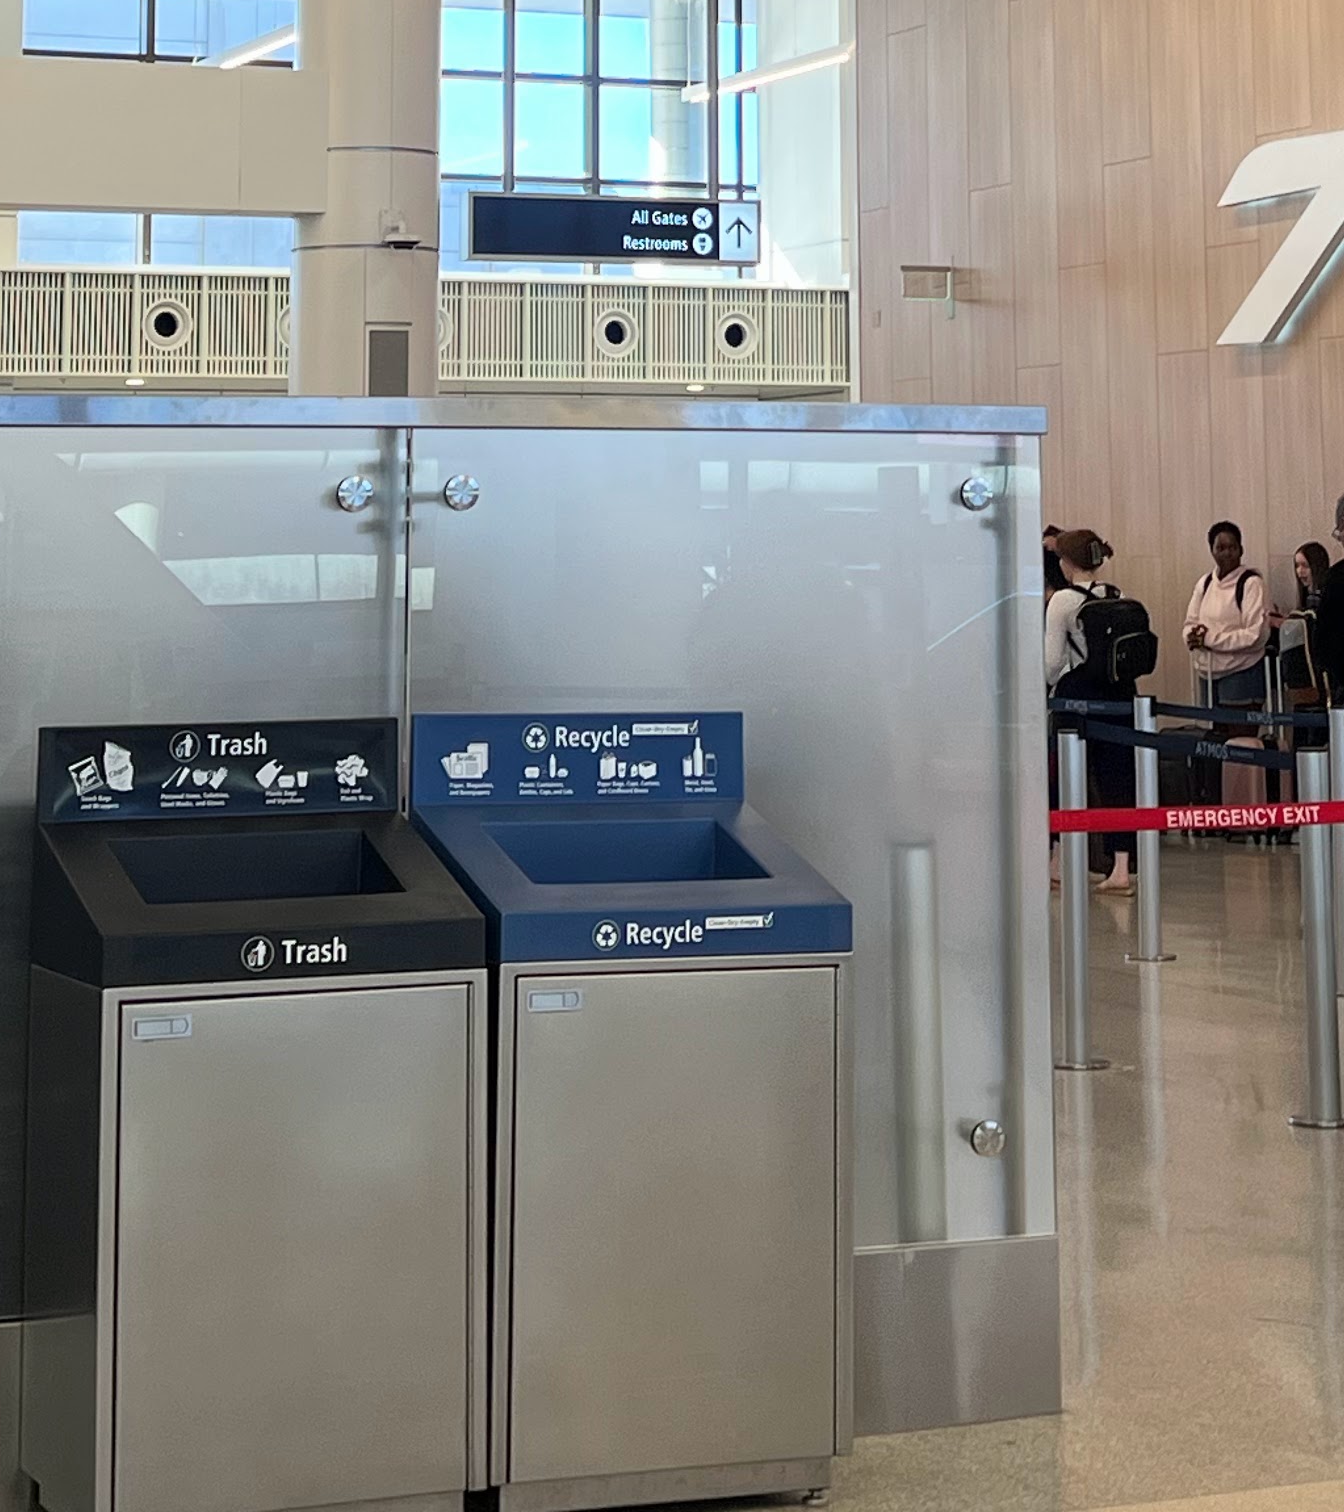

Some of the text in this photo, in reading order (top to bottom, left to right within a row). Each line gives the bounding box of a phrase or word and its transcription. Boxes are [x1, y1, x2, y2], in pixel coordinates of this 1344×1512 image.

[630, 210, 688, 226] All Gates
[623, 235, 688, 252] Restrooms
[207, 731, 268, 757] Trash
[554, 724, 631, 753] Recycle
[1195, 741, 1229, 760] ATMOS
[1166, 805, 1320, 828] EMERGENCY EXIT
[626, 920, 703, 950] Recycle
[281, 937, 347, 965] Trash
